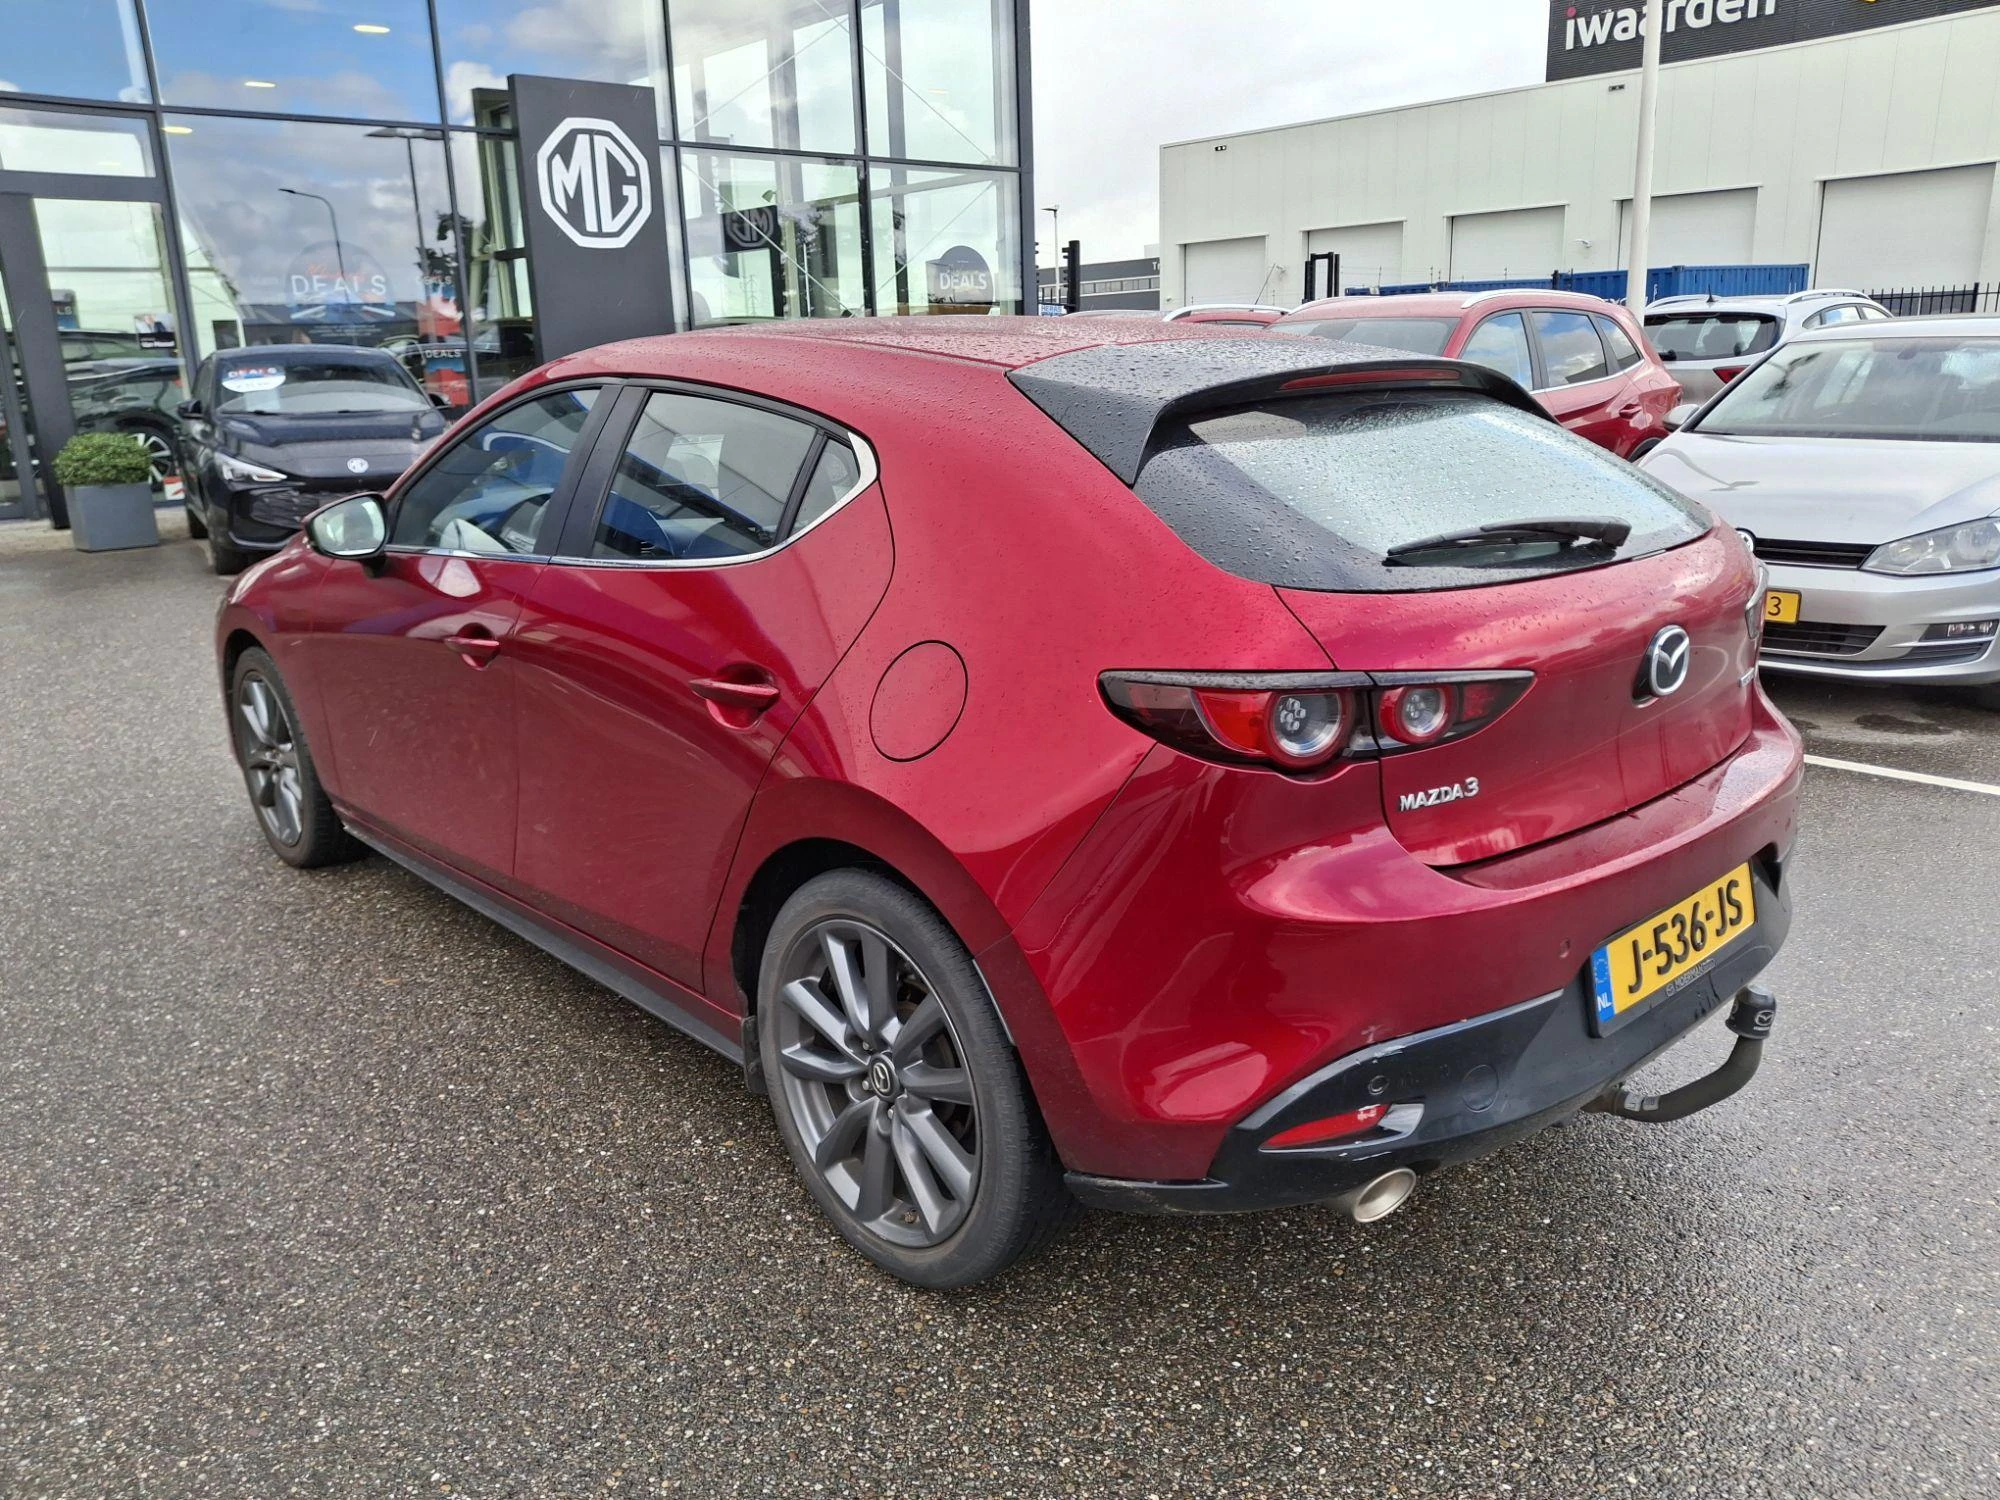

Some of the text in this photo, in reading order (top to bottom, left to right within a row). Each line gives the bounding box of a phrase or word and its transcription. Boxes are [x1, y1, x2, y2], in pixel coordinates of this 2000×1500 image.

[551, 133, 639, 232] MG
[290, 274, 387, 297] DEALS
[940, 271, 987, 290] DEALS
[425, 349, 462, 358] DEALS
[1767, 596, 1782, 616] 3
[1400, 776, 1480, 812] MAZDA3
[1627, 879, 1744, 995] J-536-JS
[1597, 993, 1612, 1012] NL
